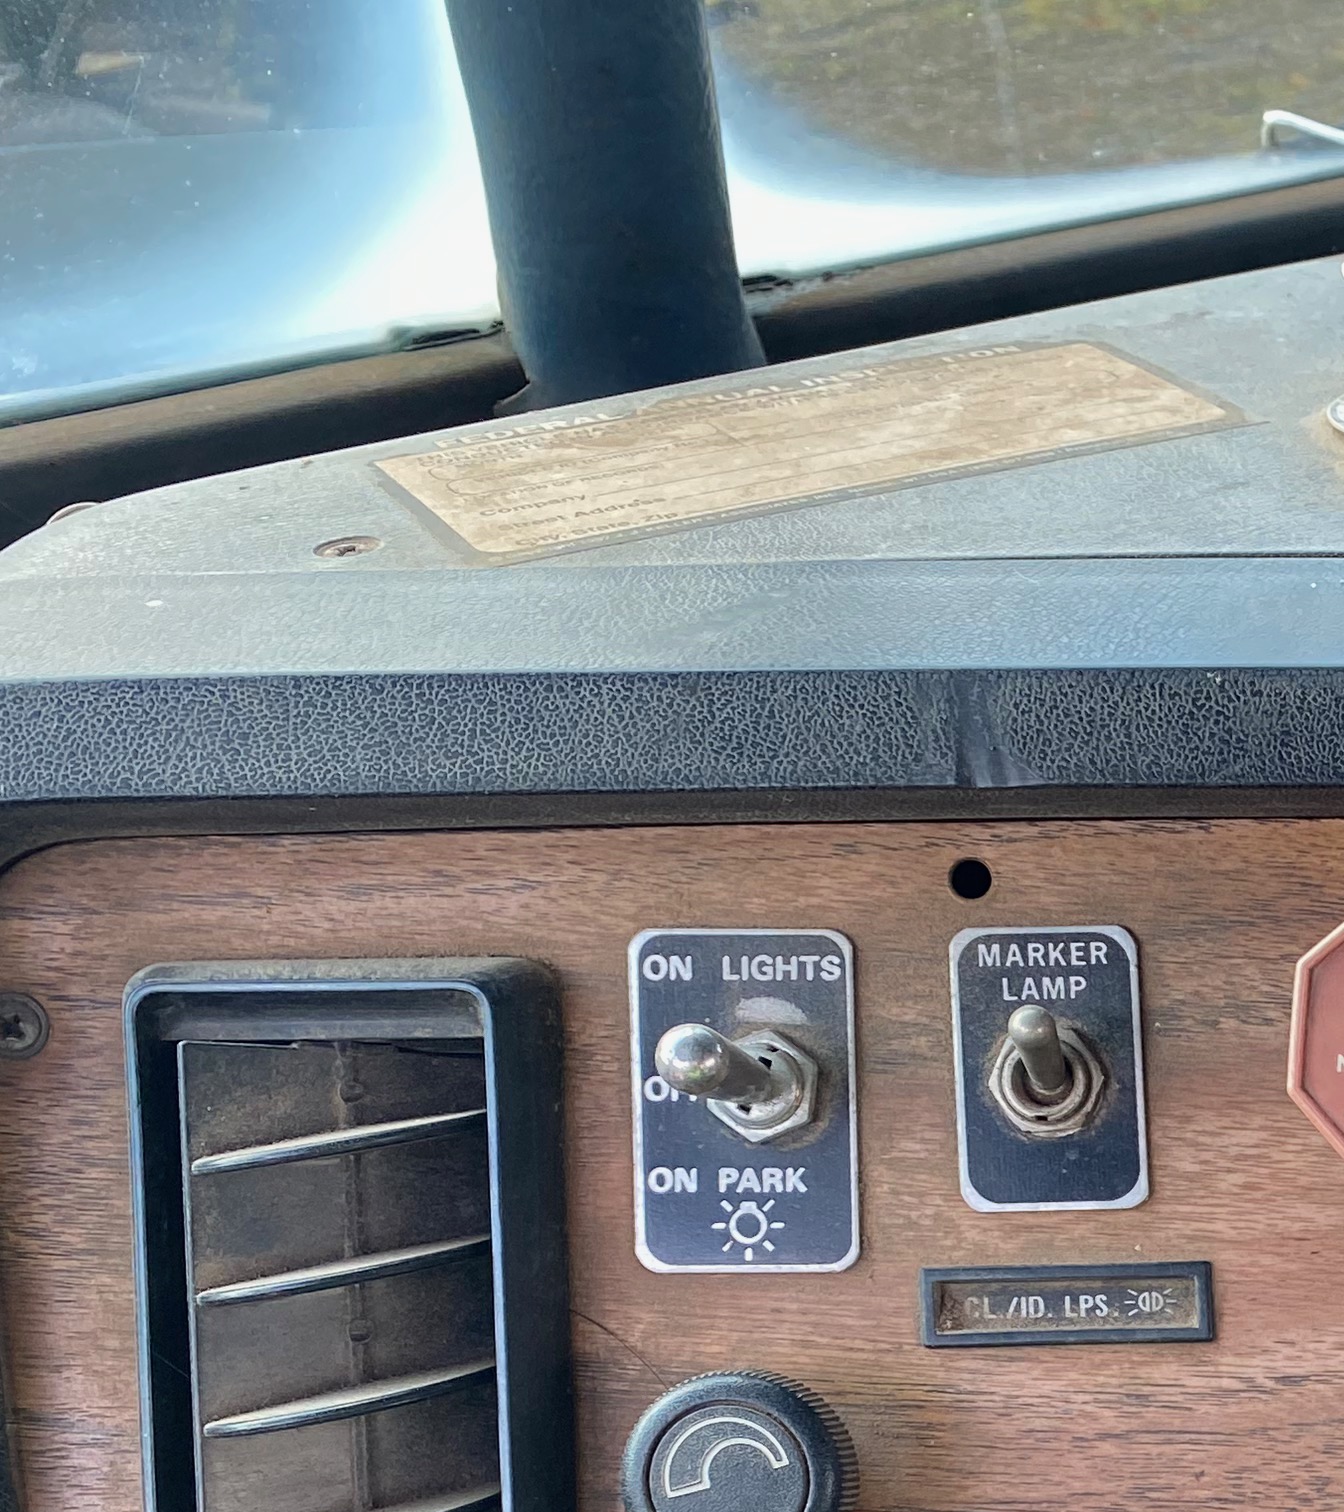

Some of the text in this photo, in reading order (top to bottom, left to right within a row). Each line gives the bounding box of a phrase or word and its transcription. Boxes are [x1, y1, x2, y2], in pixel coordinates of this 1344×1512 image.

[431, 412, 621, 449] FEDERAL
[800, 345, 1022, 387] INSPTION
[480, 493, 587, 517] Company
[573, 498, 667, 518] Address
[642, 954, 842, 982] ON LIGHTS
[977, 942, 1109, 968] MARKER
[1002, 976, 1087, 1002] LAMP
[648, 1166, 808, 1194] ON PARK
